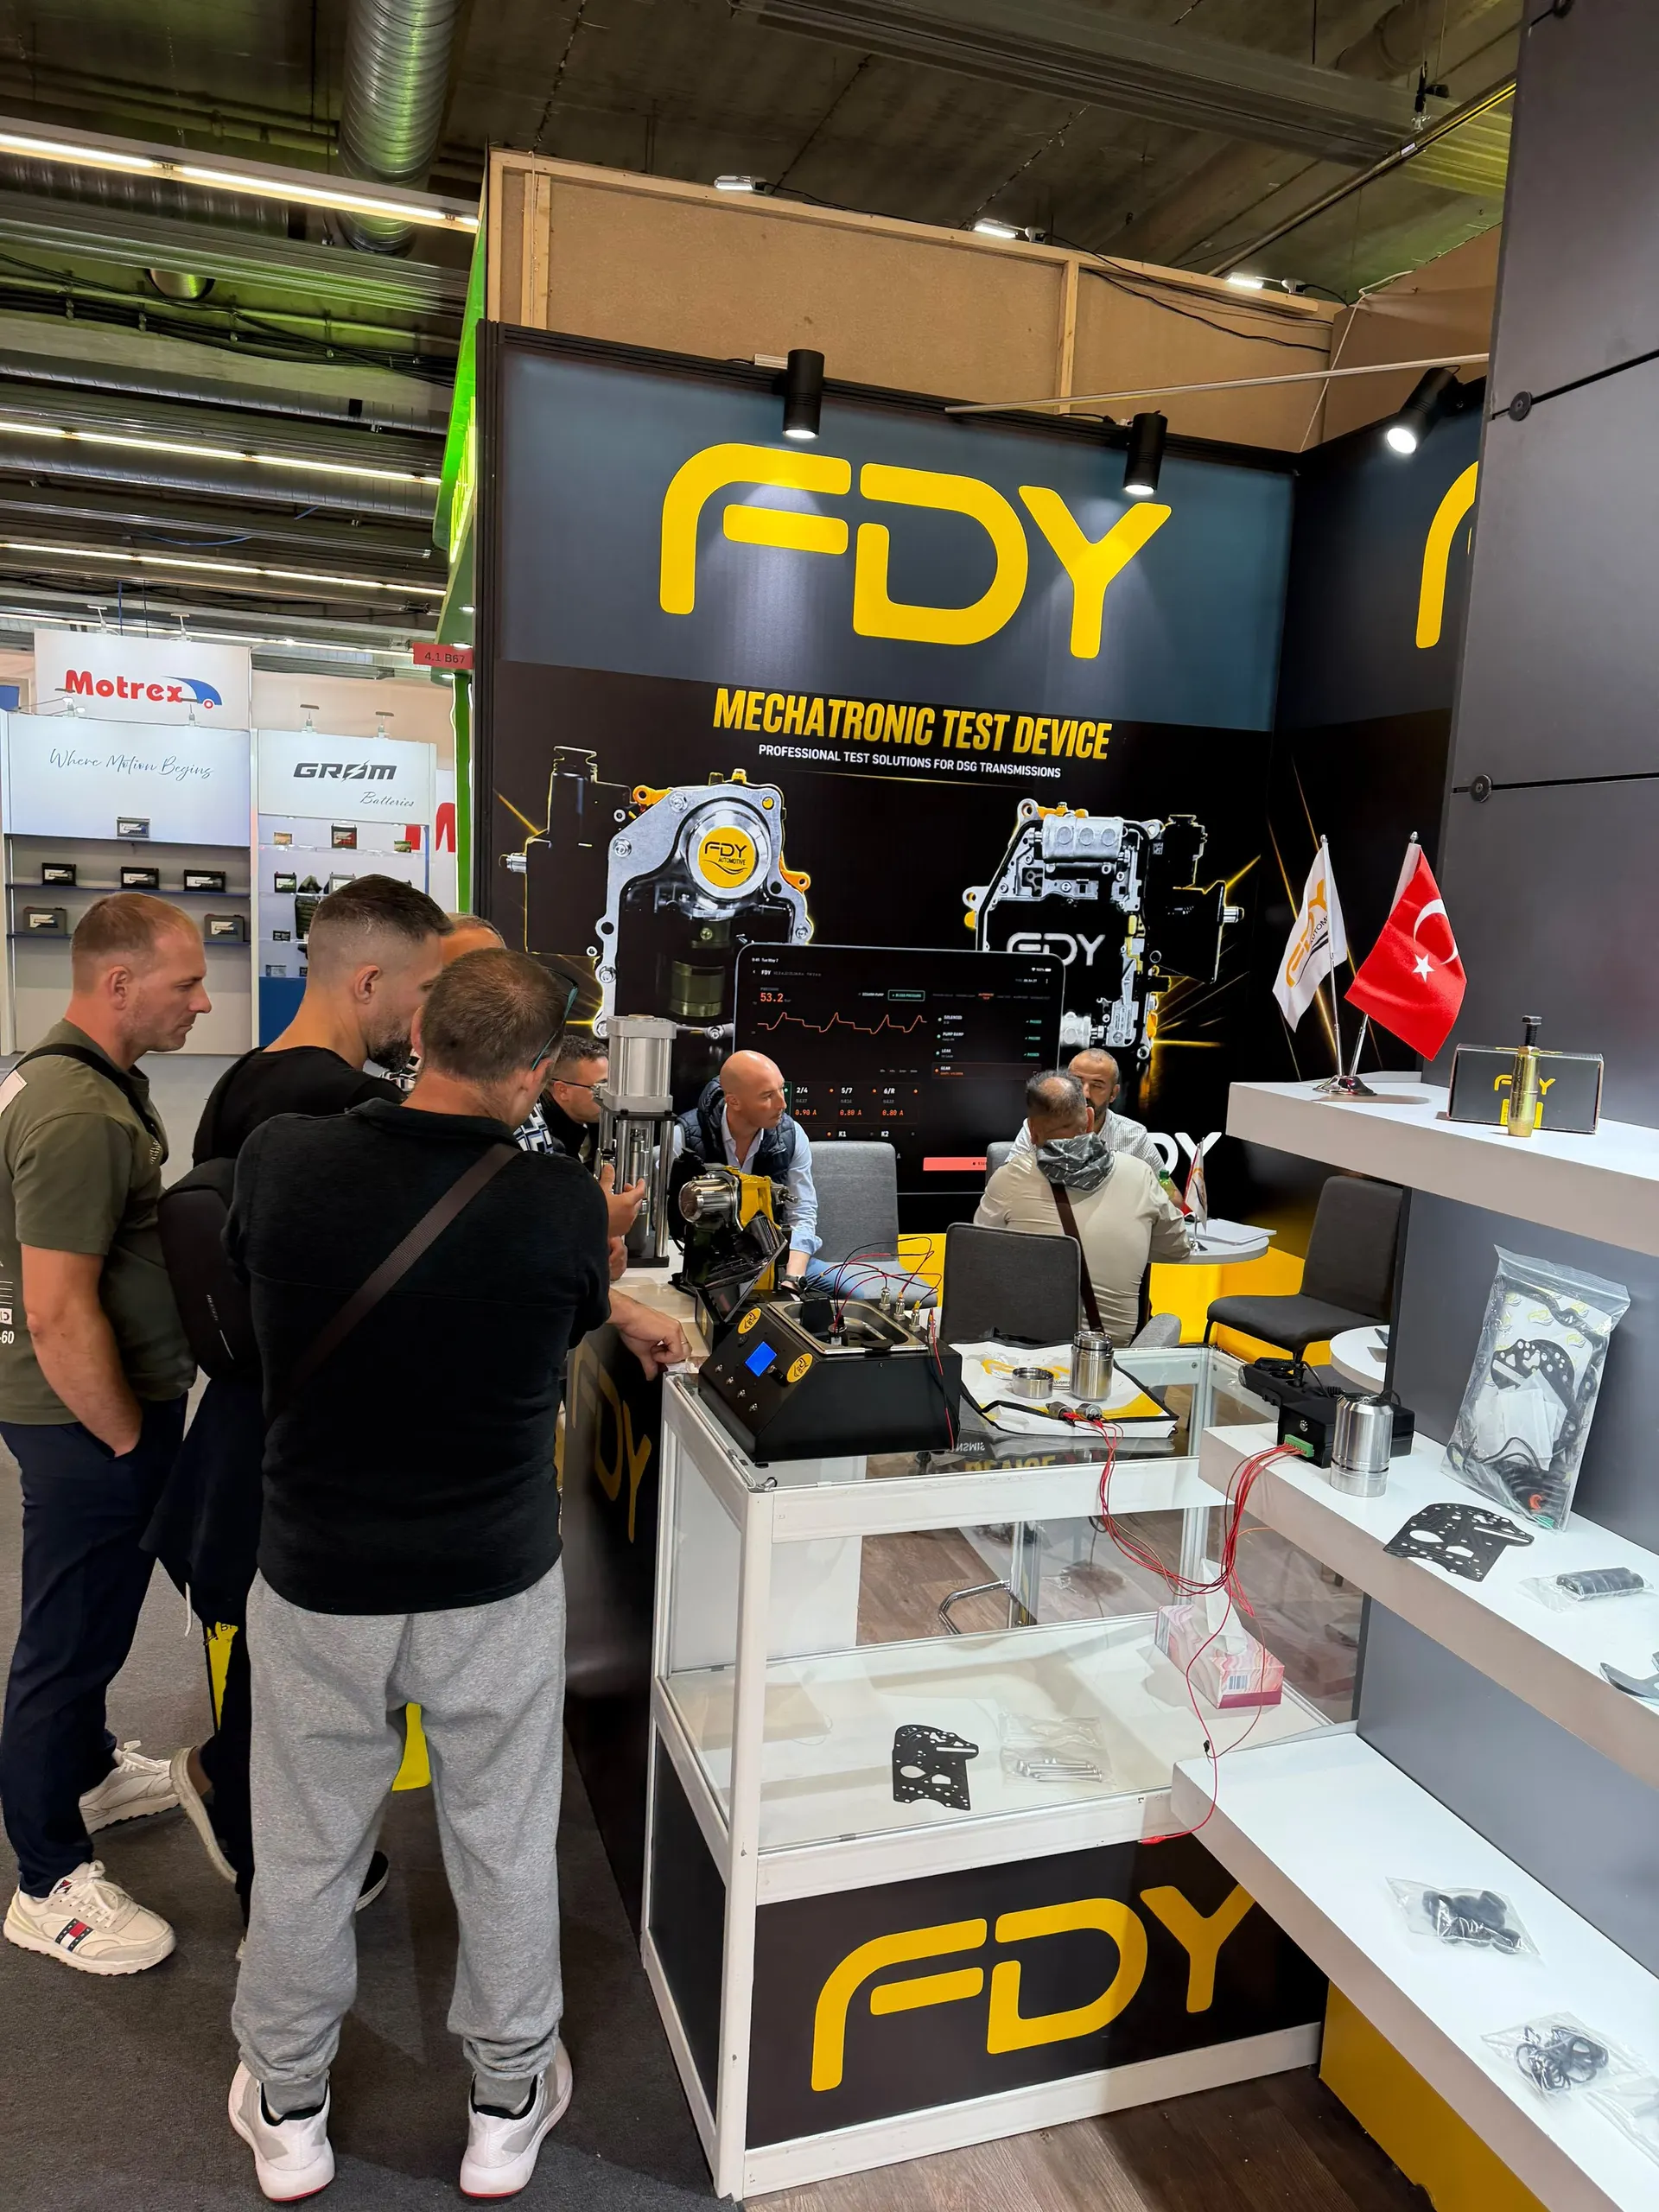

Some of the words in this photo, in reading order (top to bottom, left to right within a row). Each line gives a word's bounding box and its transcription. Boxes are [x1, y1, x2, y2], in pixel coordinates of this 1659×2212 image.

[660, 443, 1172, 659] FDY
[424, 652, 442, 663] 4.1
[445, 654, 465, 664] B67
[65, 670, 182, 702] Motrex
[713, 688, 936, 746] MECHATRONIC
[943, 709, 1011, 752] TEST
[1013, 715, 1113, 760] DEVICE
[49, 748, 101, 768] Where
[105, 754, 157, 774] Motion
[158, 755, 213, 781] Begins
[759, 744, 841, 761] PROFESSIONAL
[843, 751, 870, 764] TEST
[872, 753, 931, 769] SOLUTIONS
[933, 759, 954, 770] FOR
[956, 760, 977, 772] DSG
[980, 761, 1061, 779] TRANSMISSIONS
[359, 791, 415, 807] Batteries
[704, 841, 747, 858] FDY
[718, 856, 747, 866] AUTOMOTIVE
[760, 992, 784, 1002] 53.2
[1494, 1074, 1555, 1096] FY
[1146, 1132, 1222, 1176] DY
[810, 1885, 1256, 2092] FDY
